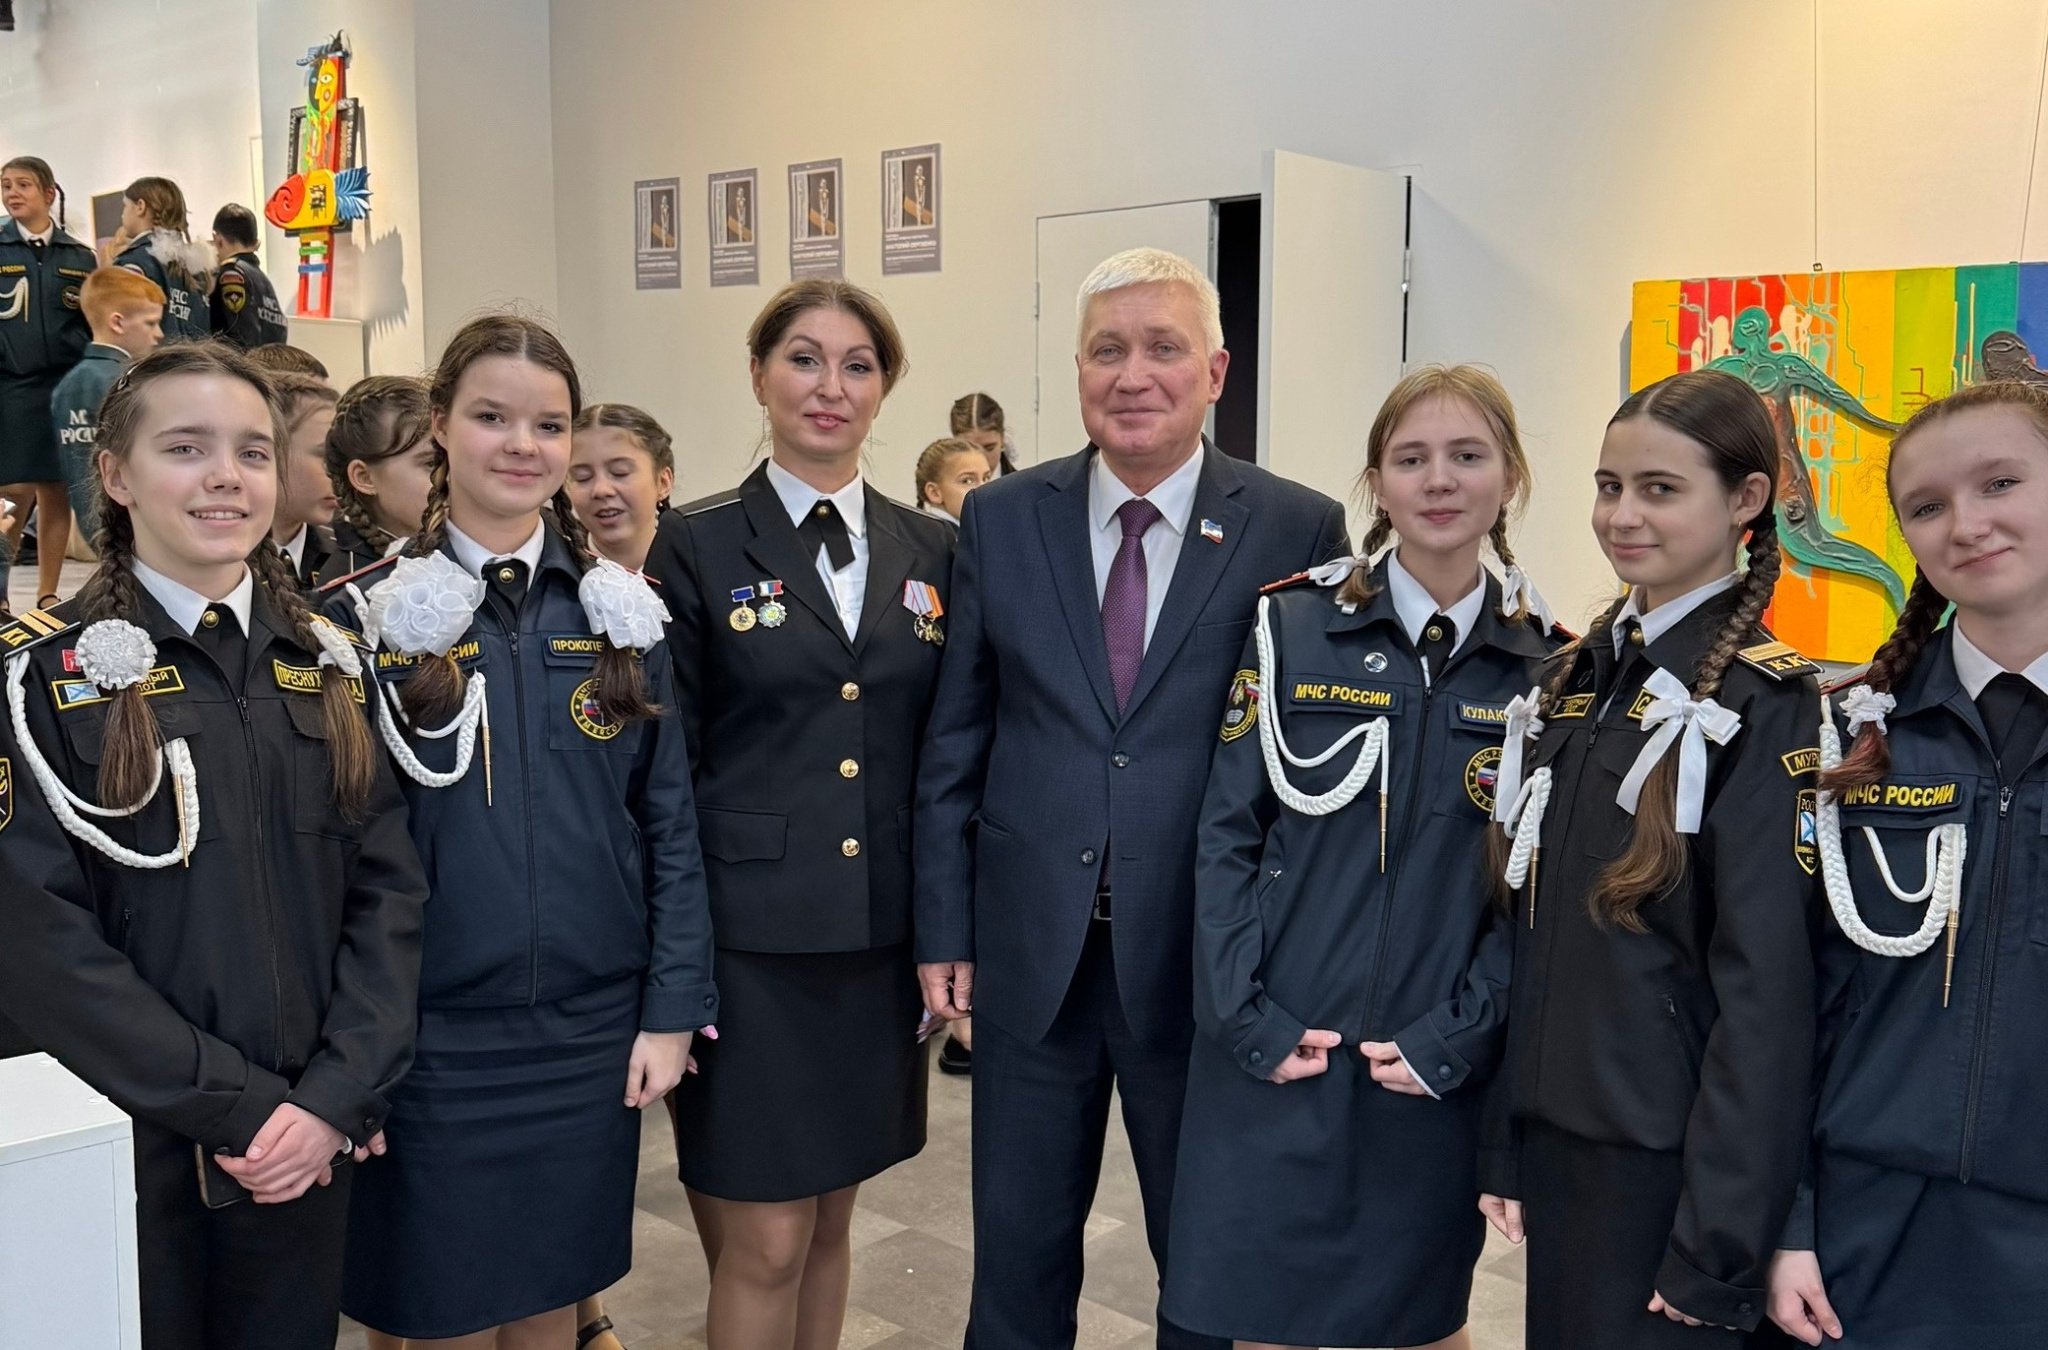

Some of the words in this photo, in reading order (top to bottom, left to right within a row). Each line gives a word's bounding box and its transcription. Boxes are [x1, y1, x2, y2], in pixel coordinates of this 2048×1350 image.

[552, 640, 605, 652] ПРОКОПЕ
[1766, 655, 1810, 671] КК
[278, 665, 325, 688] ПРЕСНУХ
[1294, 684, 1328, 700] МЧС
[1330, 685, 1392, 707] РОССИИ
[1843, 784, 1881, 806] МЧС
[1884, 783, 1956, 807] РОССИИ
